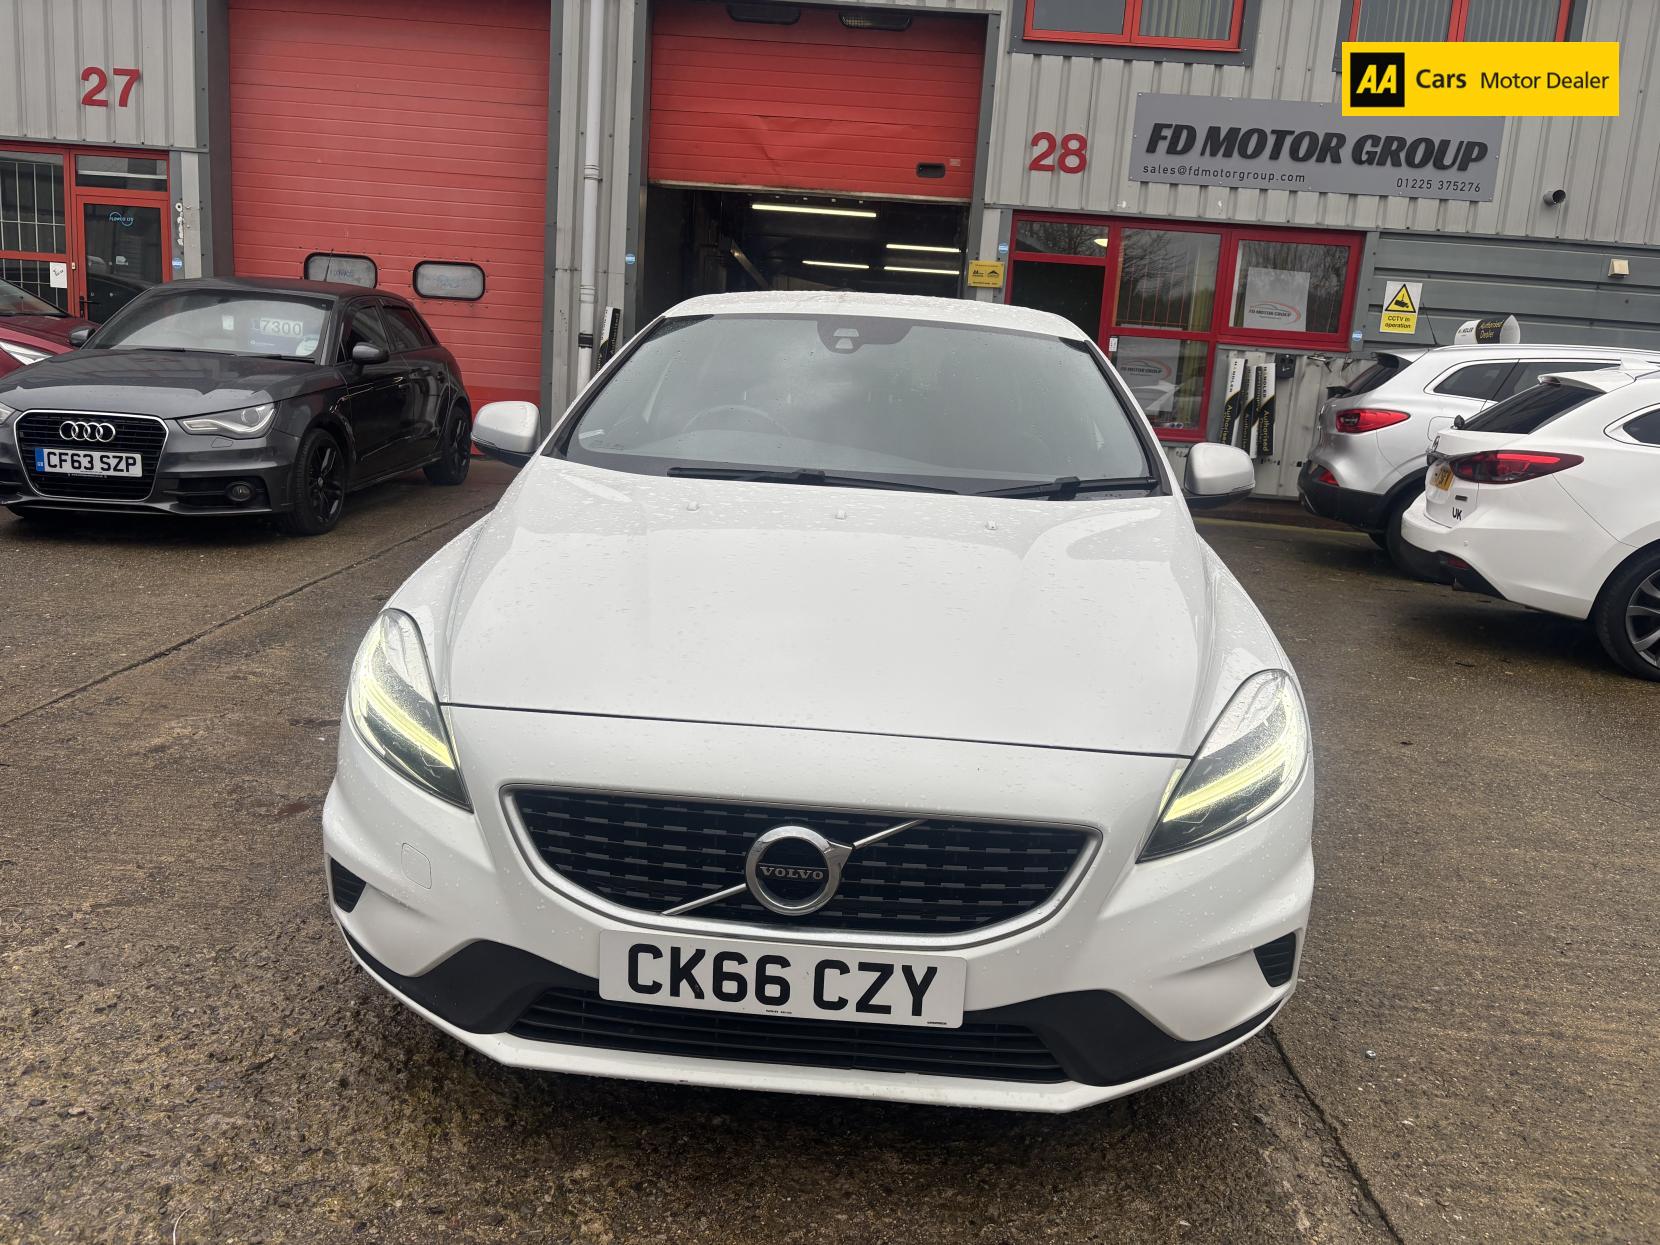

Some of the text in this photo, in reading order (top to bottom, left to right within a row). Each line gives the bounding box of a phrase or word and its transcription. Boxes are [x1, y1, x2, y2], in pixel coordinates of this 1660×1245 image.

[81, 66, 141, 107] 27
[1029, 132, 1088, 174] 28
[1145, 122, 1489, 172] FD MOTOR GROUP
[1142, 164, 1305, 183] sales@fdmotorgroup.com
[1396, 177, 1481, 193] 01225 375276
[47, 451, 137, 473] CF63 SZP
[1452, 507, 1462, 520] UK
[760, 866, 824, 880] VOLVO
[627, 943, 938, 1017] CK66 CZY
